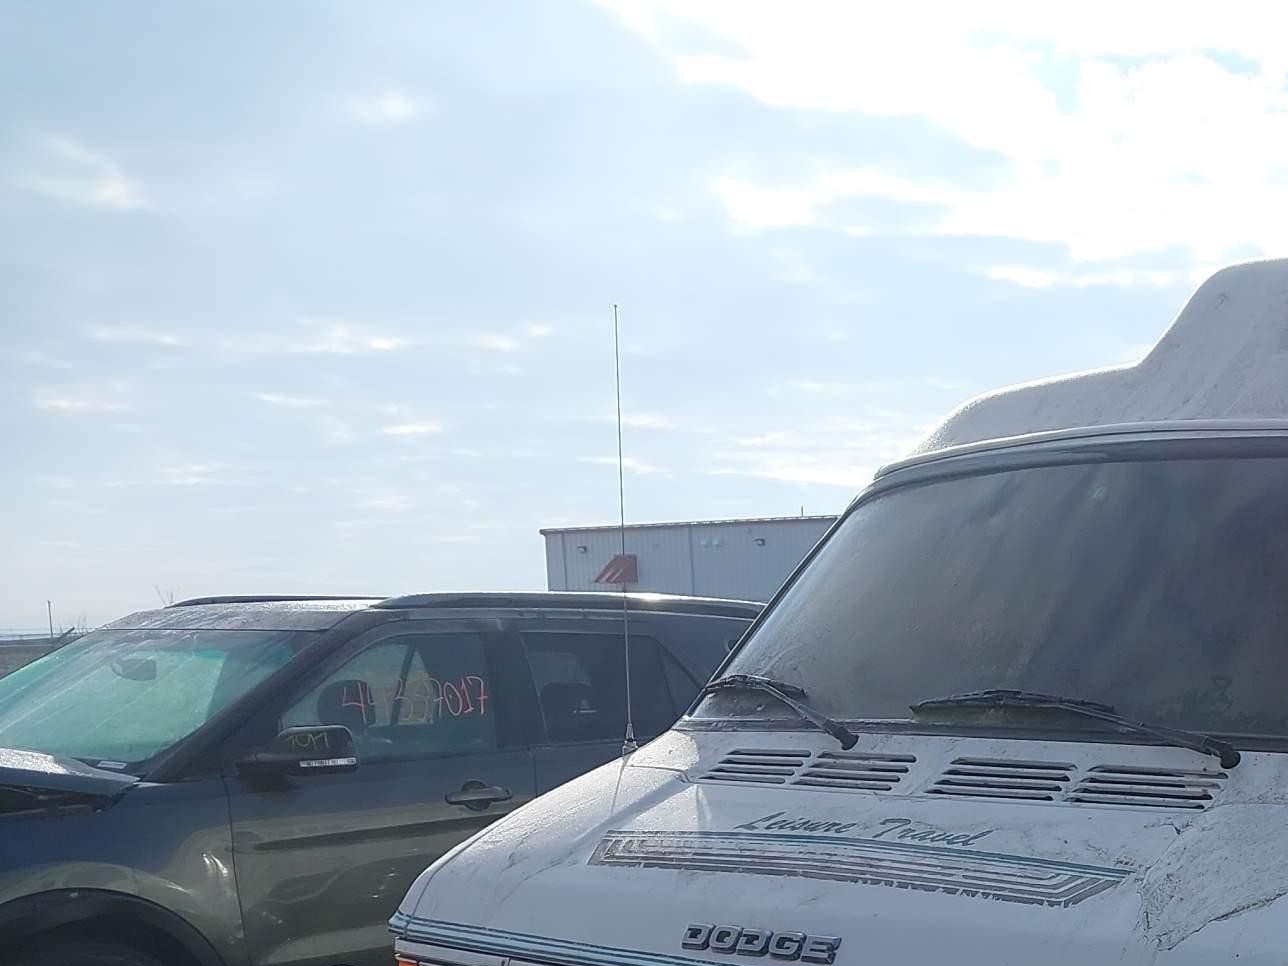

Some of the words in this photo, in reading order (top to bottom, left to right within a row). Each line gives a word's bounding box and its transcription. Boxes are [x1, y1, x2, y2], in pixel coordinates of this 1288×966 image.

[733, 810, 859, 834] Leisure
[872, 817, 992, 848] Travel
[682, 924, 841, 965] DODGE
